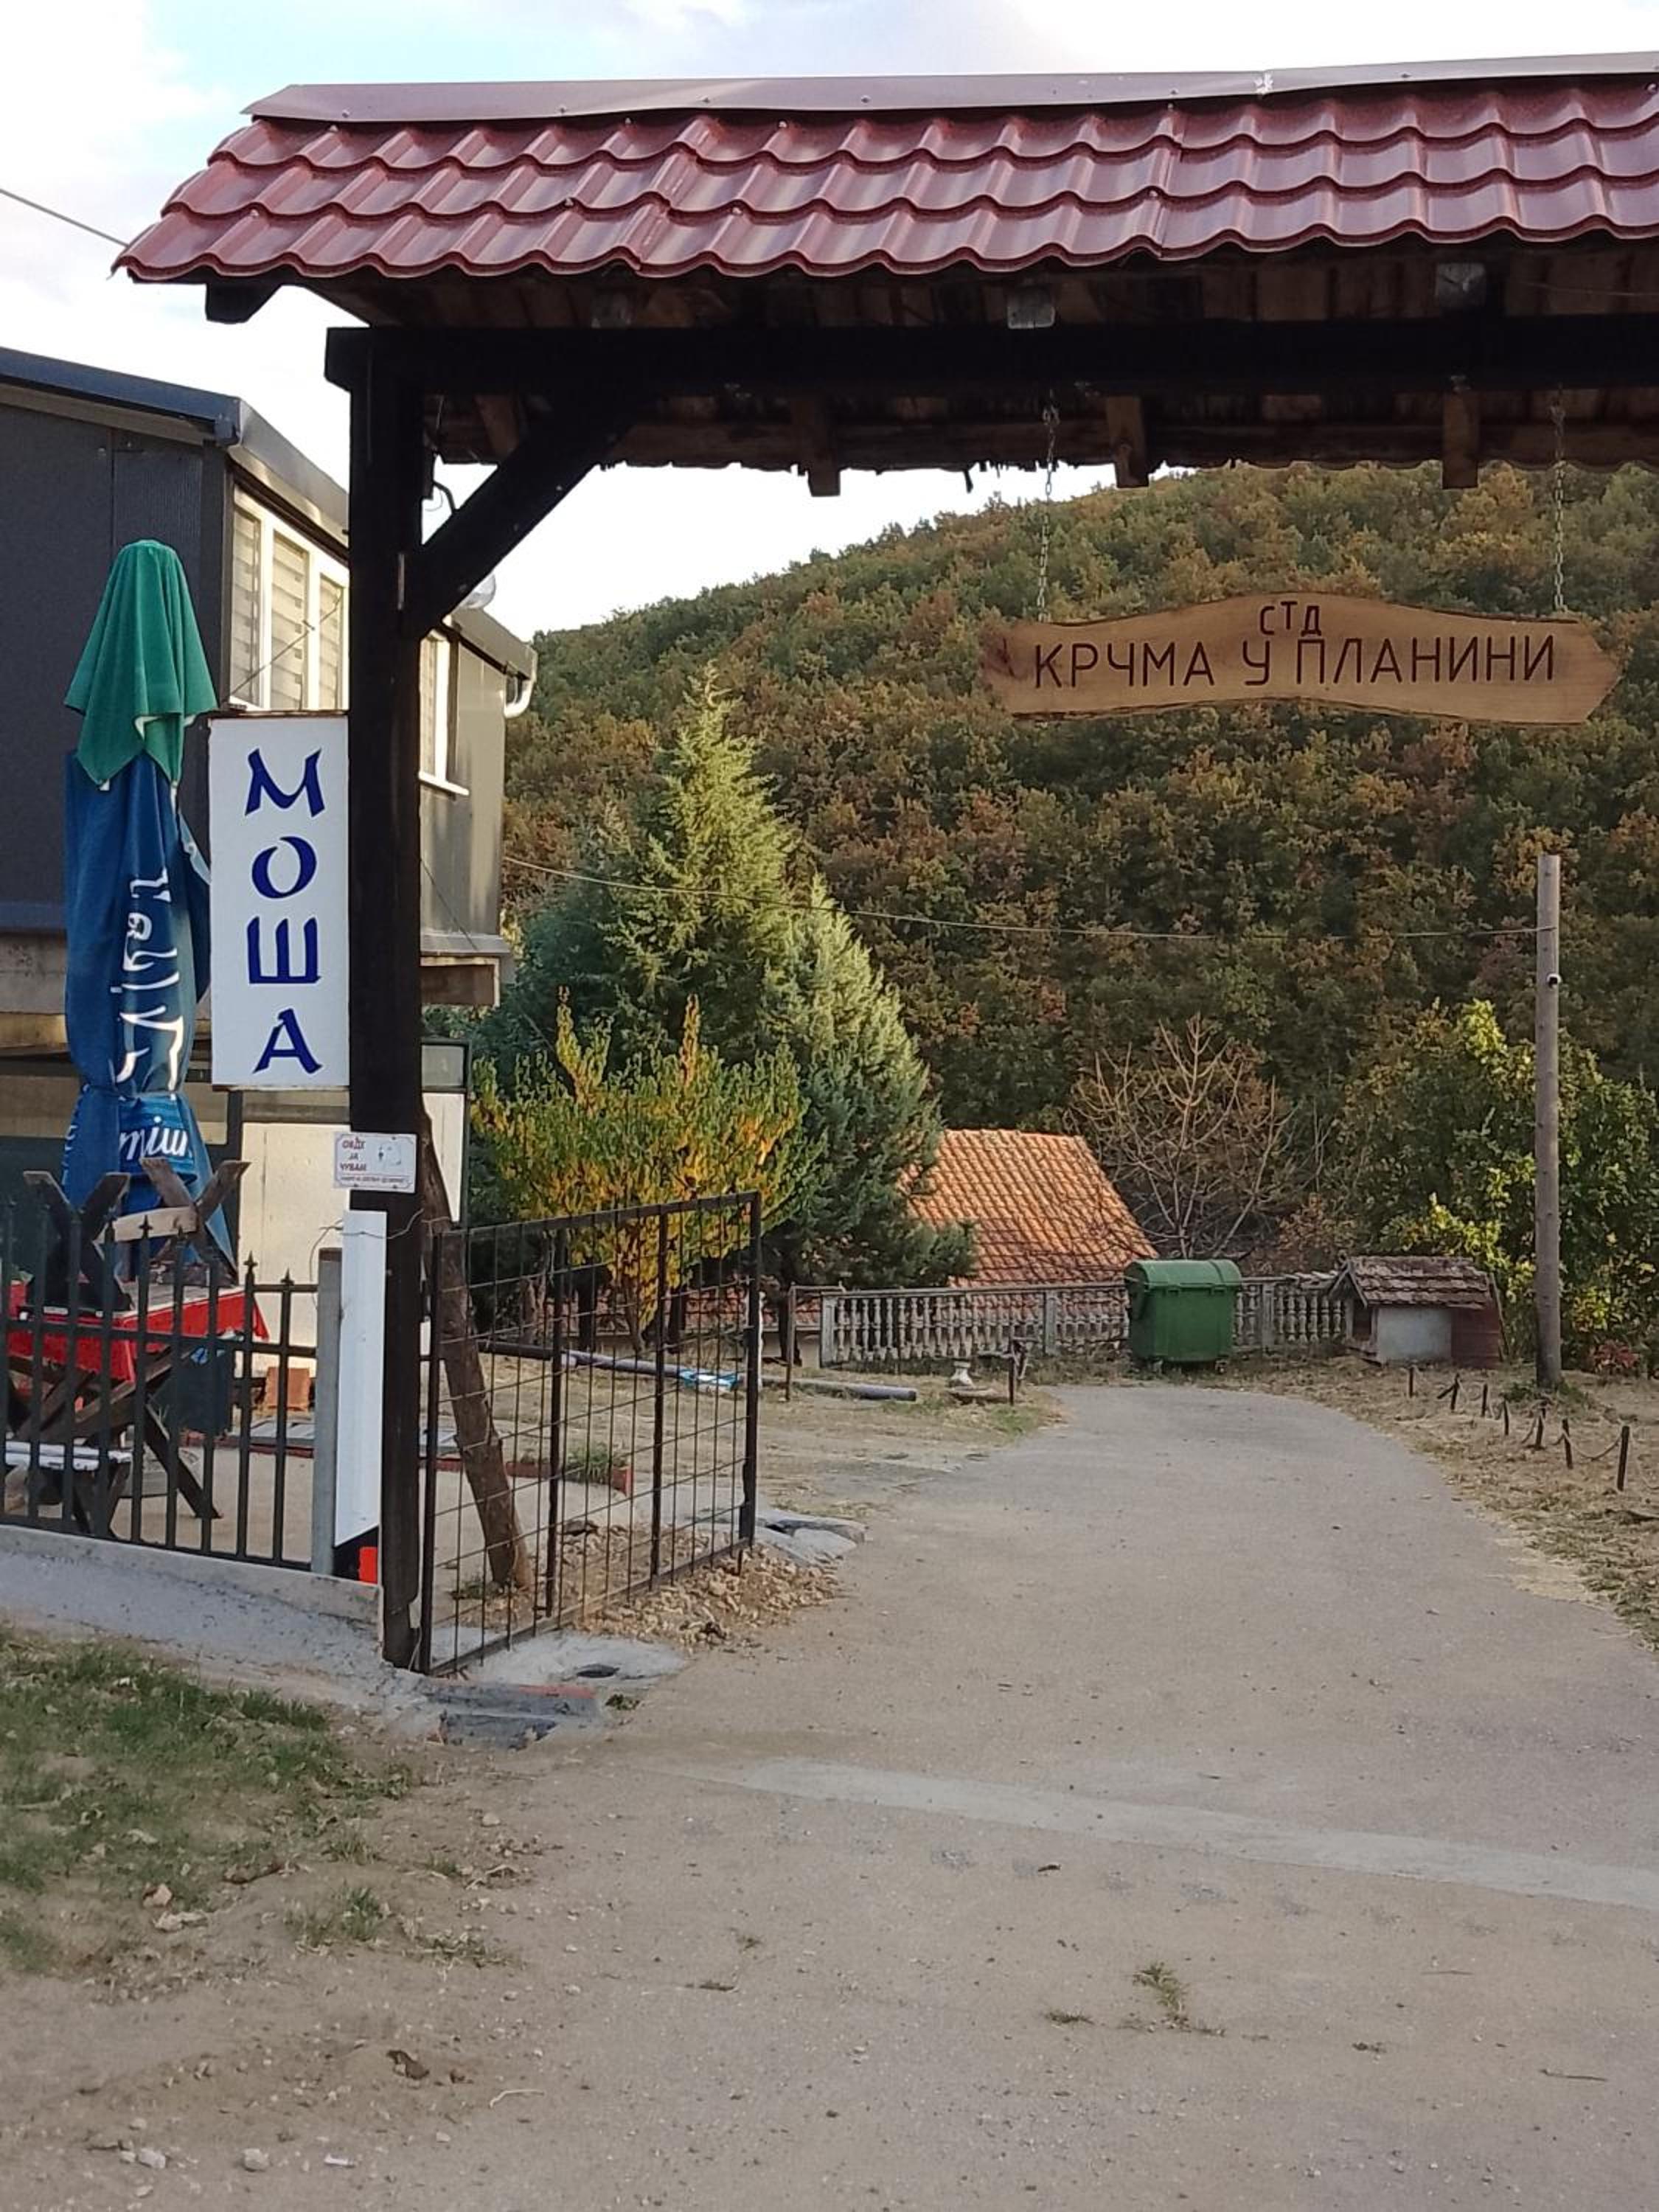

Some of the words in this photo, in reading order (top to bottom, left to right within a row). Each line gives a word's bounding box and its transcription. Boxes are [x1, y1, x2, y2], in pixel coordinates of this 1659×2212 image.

[1259, 601, 1322, 637] СТД
[1034, 641, 1215, 688] КРЧМА
[1242, 640, 1270, 686] У
[1295, 635, 1554, 684] ПЛАНИНИ
[244, 747, 326, 1075] МОША
